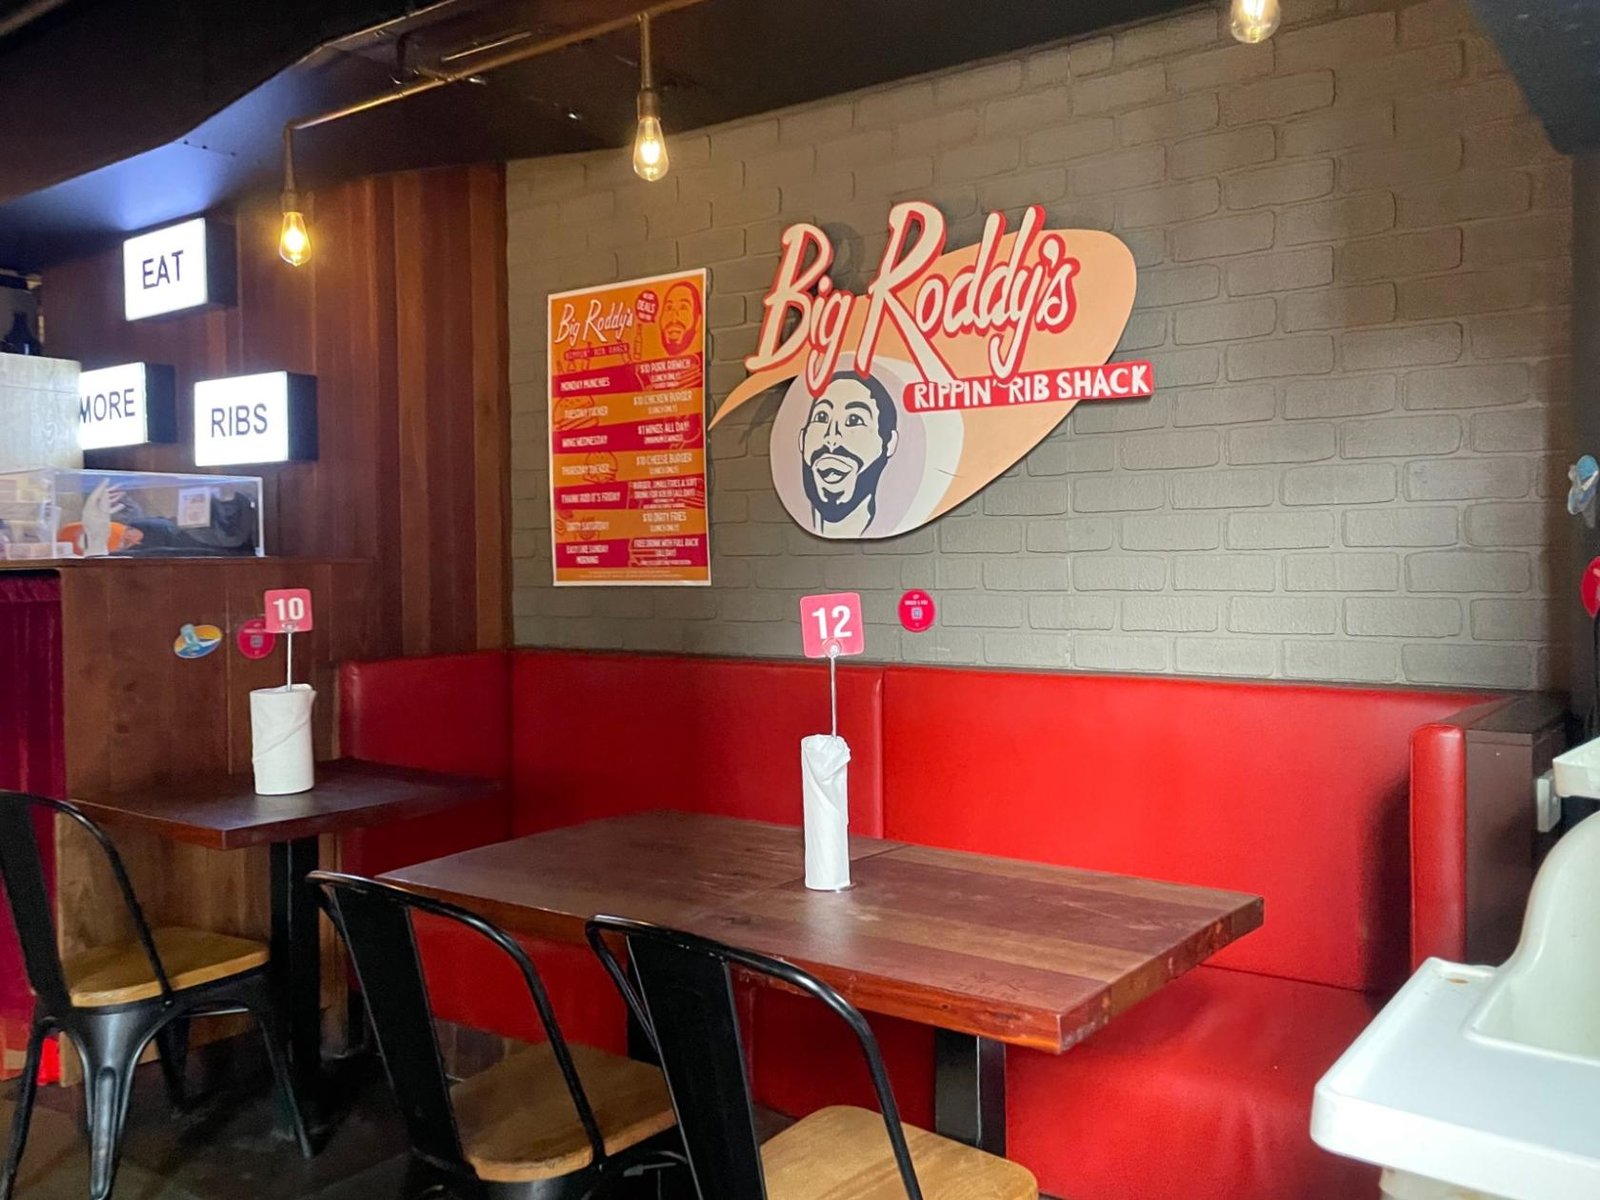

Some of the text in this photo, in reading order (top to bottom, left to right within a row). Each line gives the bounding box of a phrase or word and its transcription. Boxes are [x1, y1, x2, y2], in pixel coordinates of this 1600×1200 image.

[142, 250, 184, 290] EAT
[636, 300, 656, 313] DEALS
[743, 200, 1080, 396] Big Roddy's
[554, 299, 634, 346] Big Roddy's
[914, 365, 1150, 409] RIPPIN' RIB SHACK
[80, 388, 136, 424] MORE
[211, 403, 268, 438] RIBS
[273, 597, 304, 621] 10
[812, 605, 852, 639] 12
